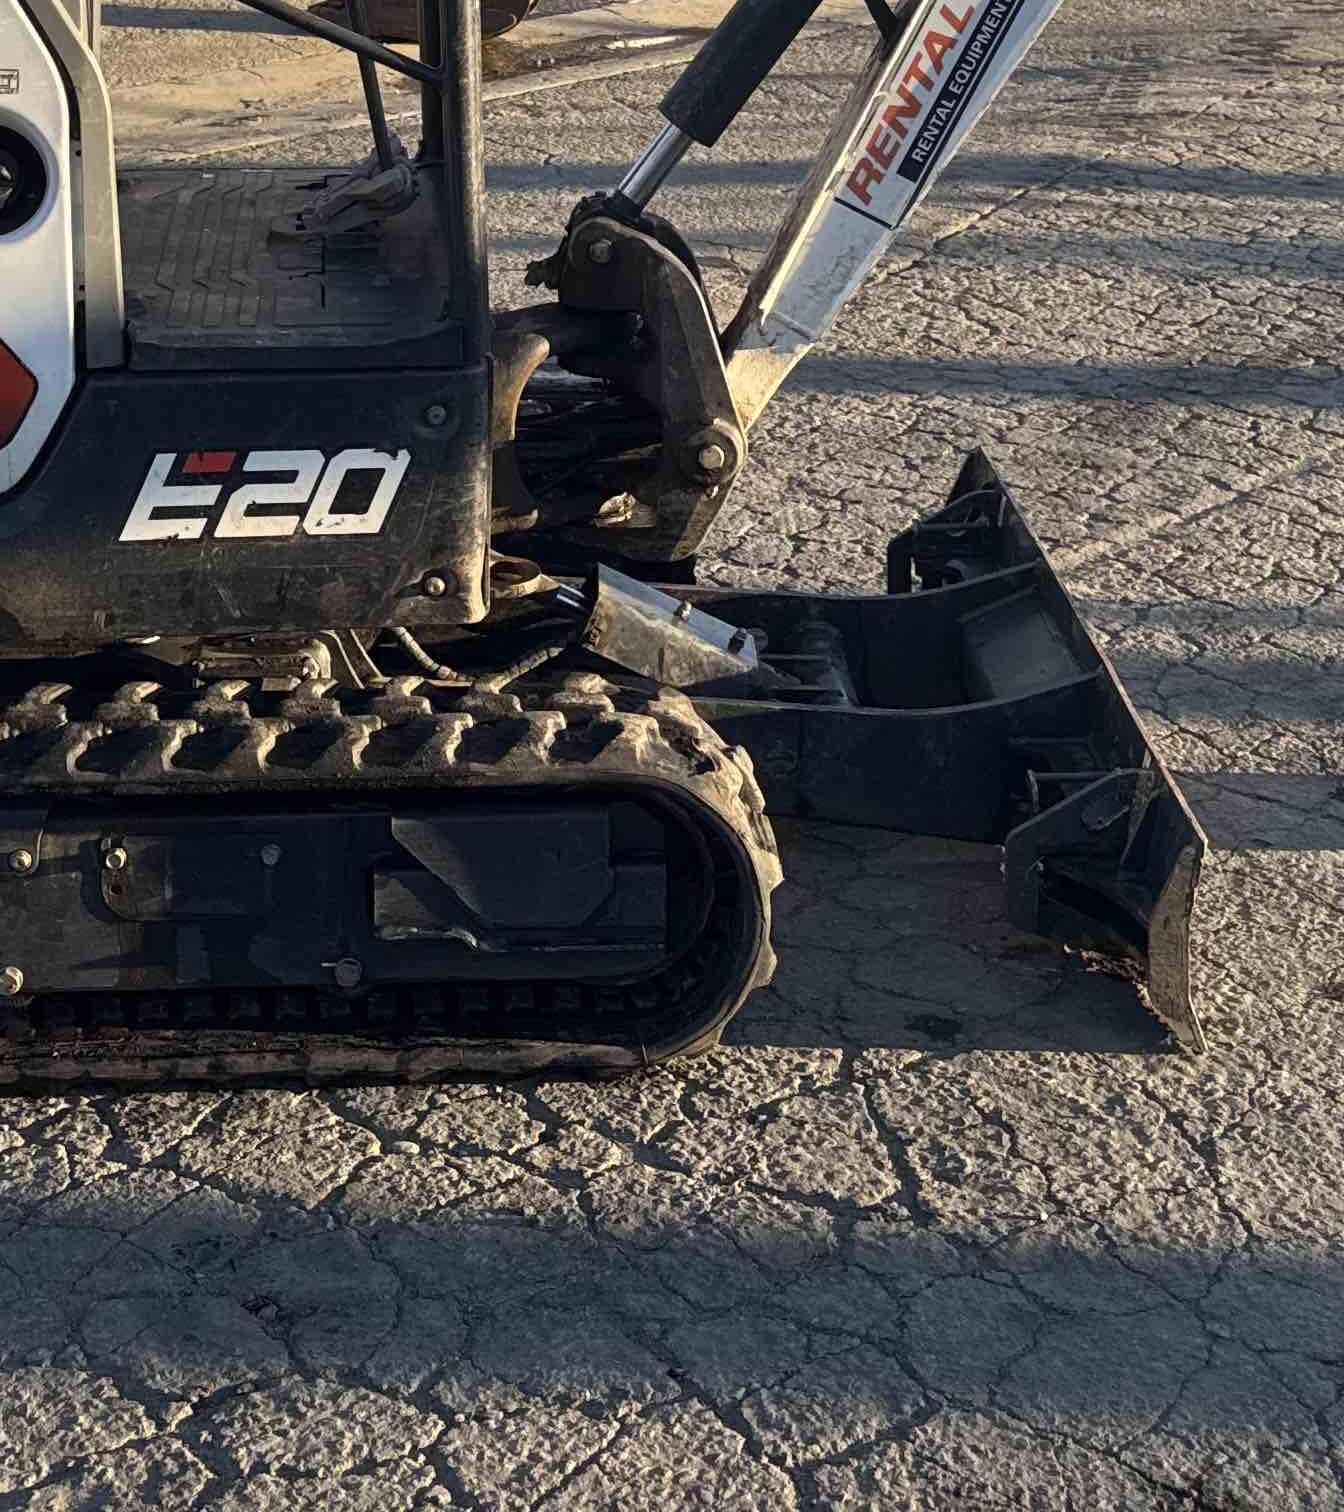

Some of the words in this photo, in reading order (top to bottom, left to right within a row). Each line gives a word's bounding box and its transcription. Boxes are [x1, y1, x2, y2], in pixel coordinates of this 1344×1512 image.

[846, 4, 975, 206] RENTAL
[912, 99, 956, 162] RENTAL
[118, 448, 411, 542] E20
